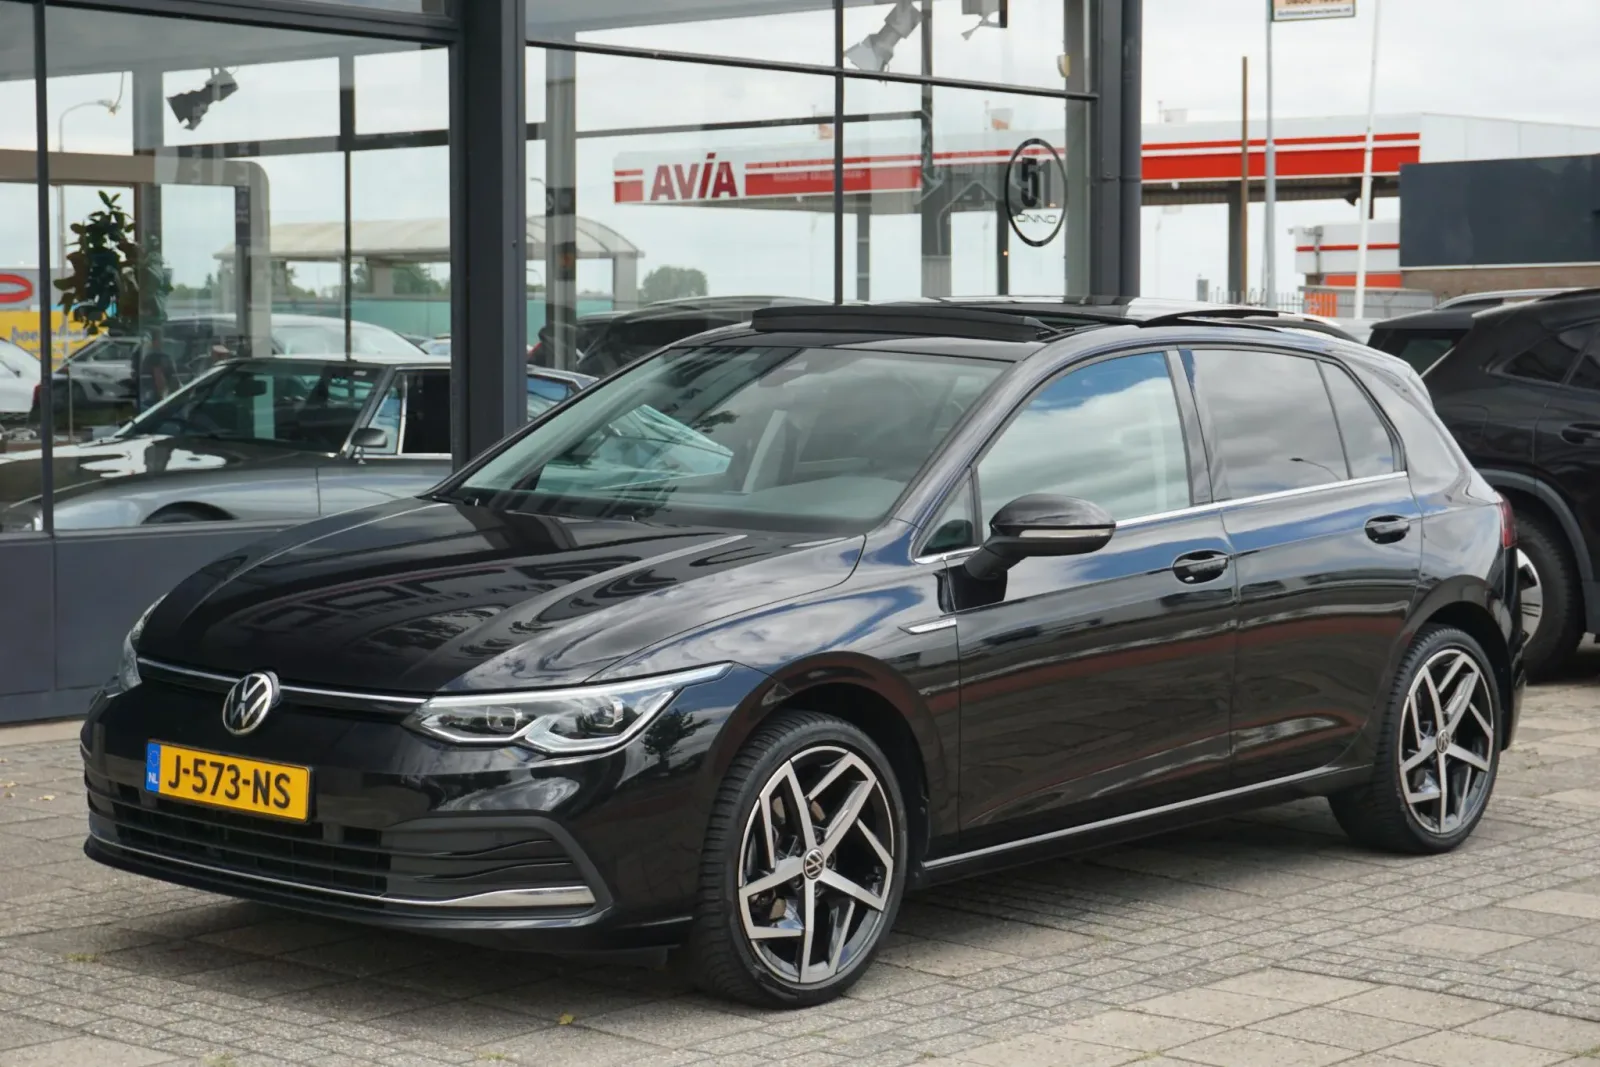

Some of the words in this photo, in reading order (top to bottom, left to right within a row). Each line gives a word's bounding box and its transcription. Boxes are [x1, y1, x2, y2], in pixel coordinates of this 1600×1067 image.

[1021, 157, 1051, 207] 51
[148, 771, 159, 784] NL
[168, 754, 291, 809] J-573-NS
